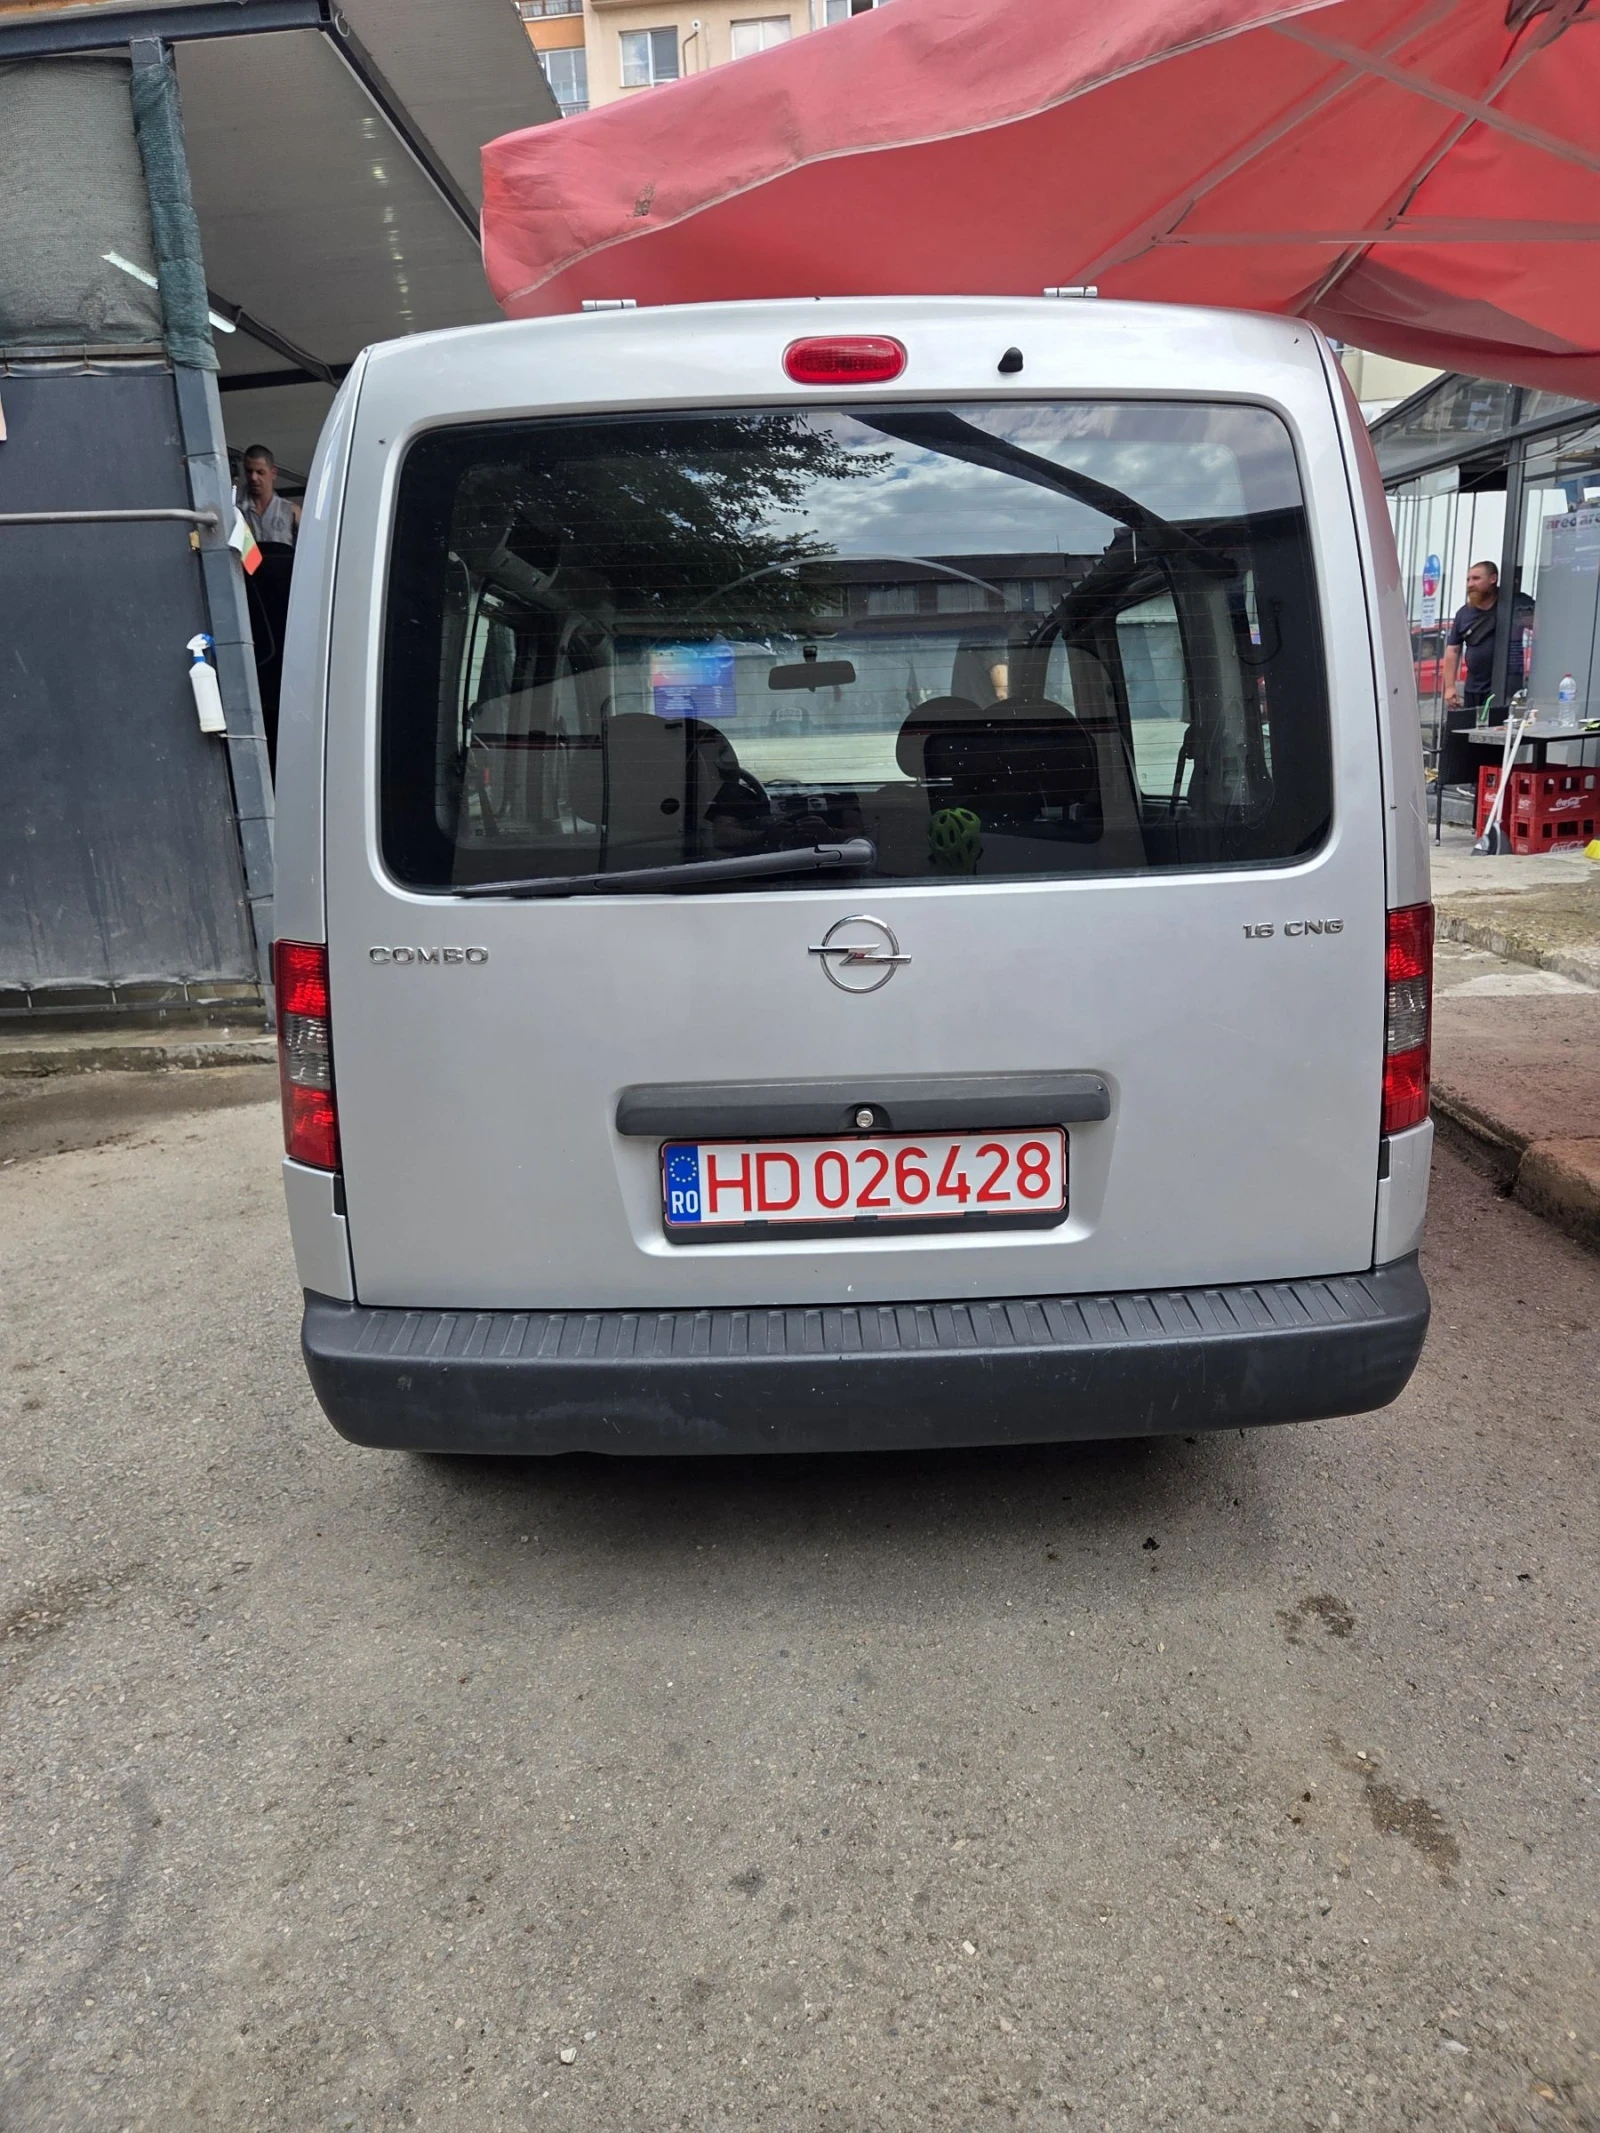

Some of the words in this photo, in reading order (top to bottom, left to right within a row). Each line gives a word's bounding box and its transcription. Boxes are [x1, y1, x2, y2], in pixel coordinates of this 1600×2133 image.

[1284, 918, 1344, 936] CNG
[369, 945, 489, 965] COMBO
[706, 1151, 801, 1213] HD
[814, 1141, 1051, 1209] 026428
[672, 1190, 699, 1214] RO
